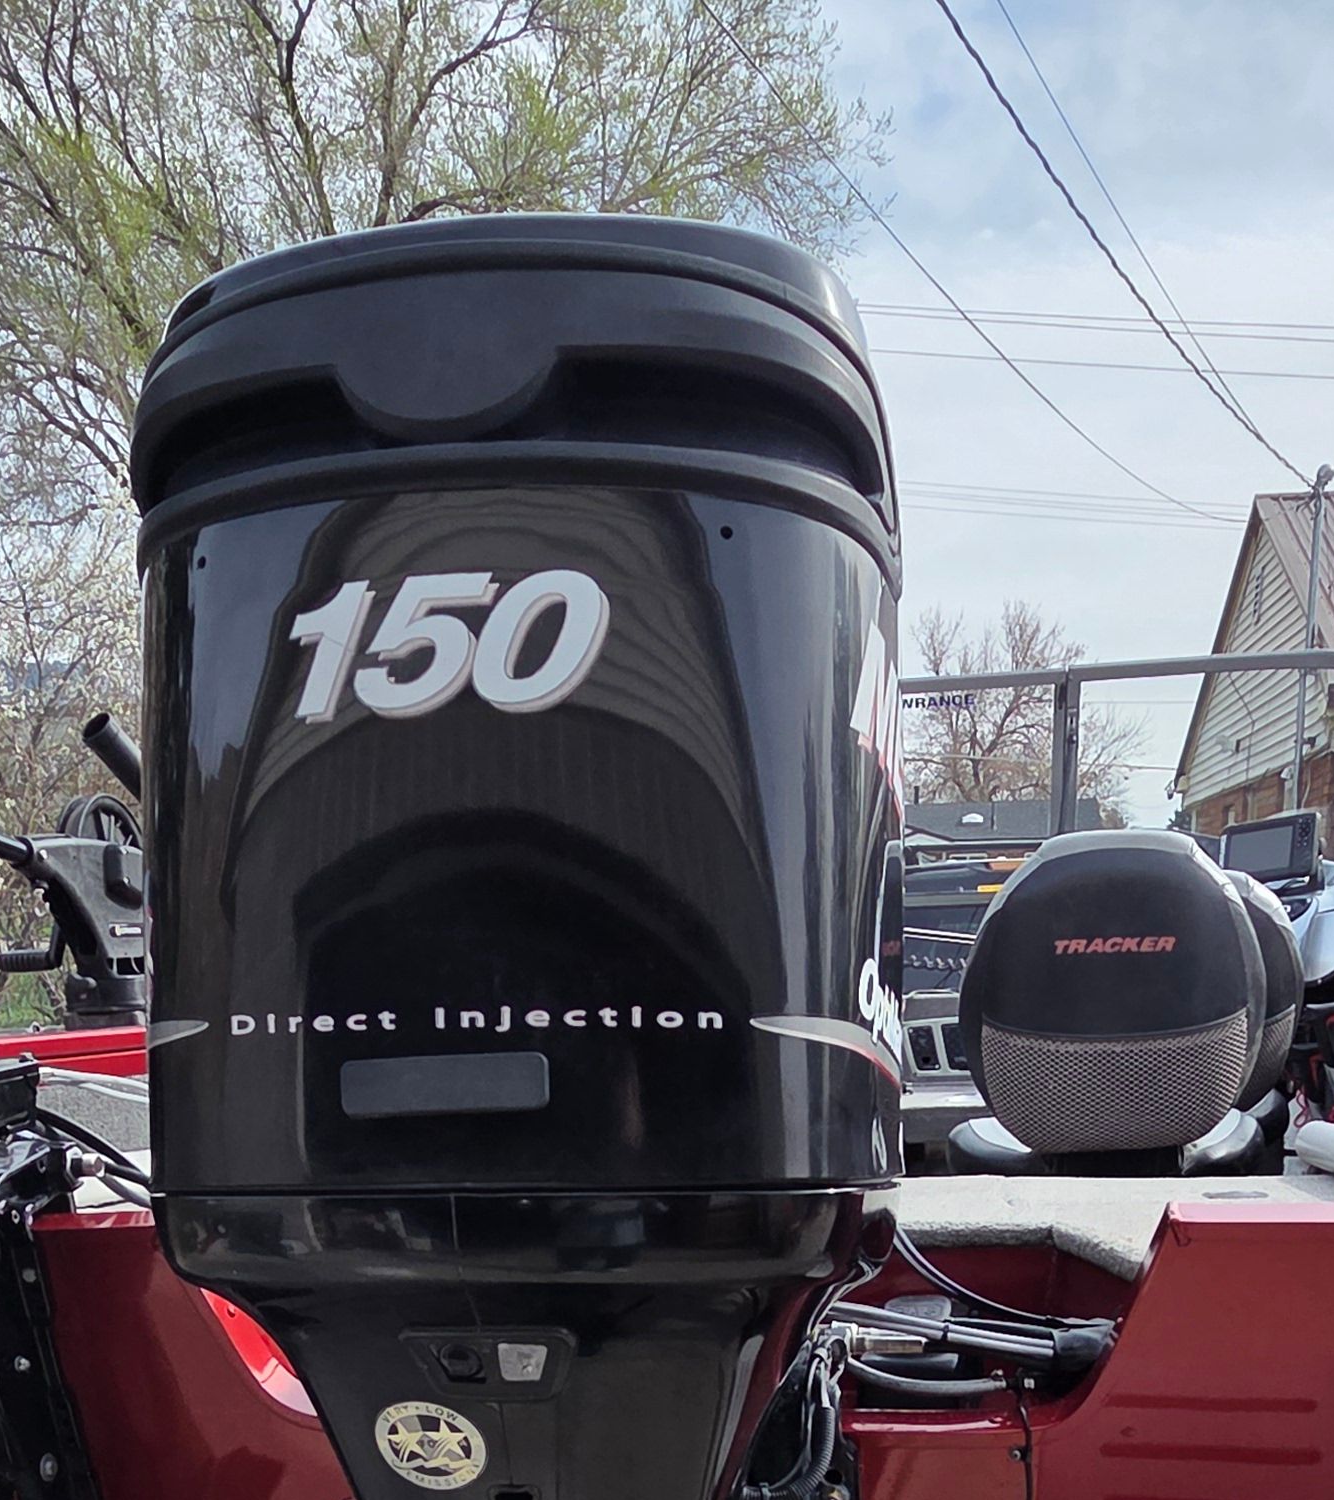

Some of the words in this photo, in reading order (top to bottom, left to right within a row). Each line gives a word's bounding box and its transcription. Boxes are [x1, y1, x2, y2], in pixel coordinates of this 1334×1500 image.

[289, 569, 610, 724] 150
[1054, 936, 1176, 955] TRACKER
[230, 1010, 396, 1036] Direct
[434, 1005, 724, 1033] Injection
[425, 1405, 458, 1422] LOW
